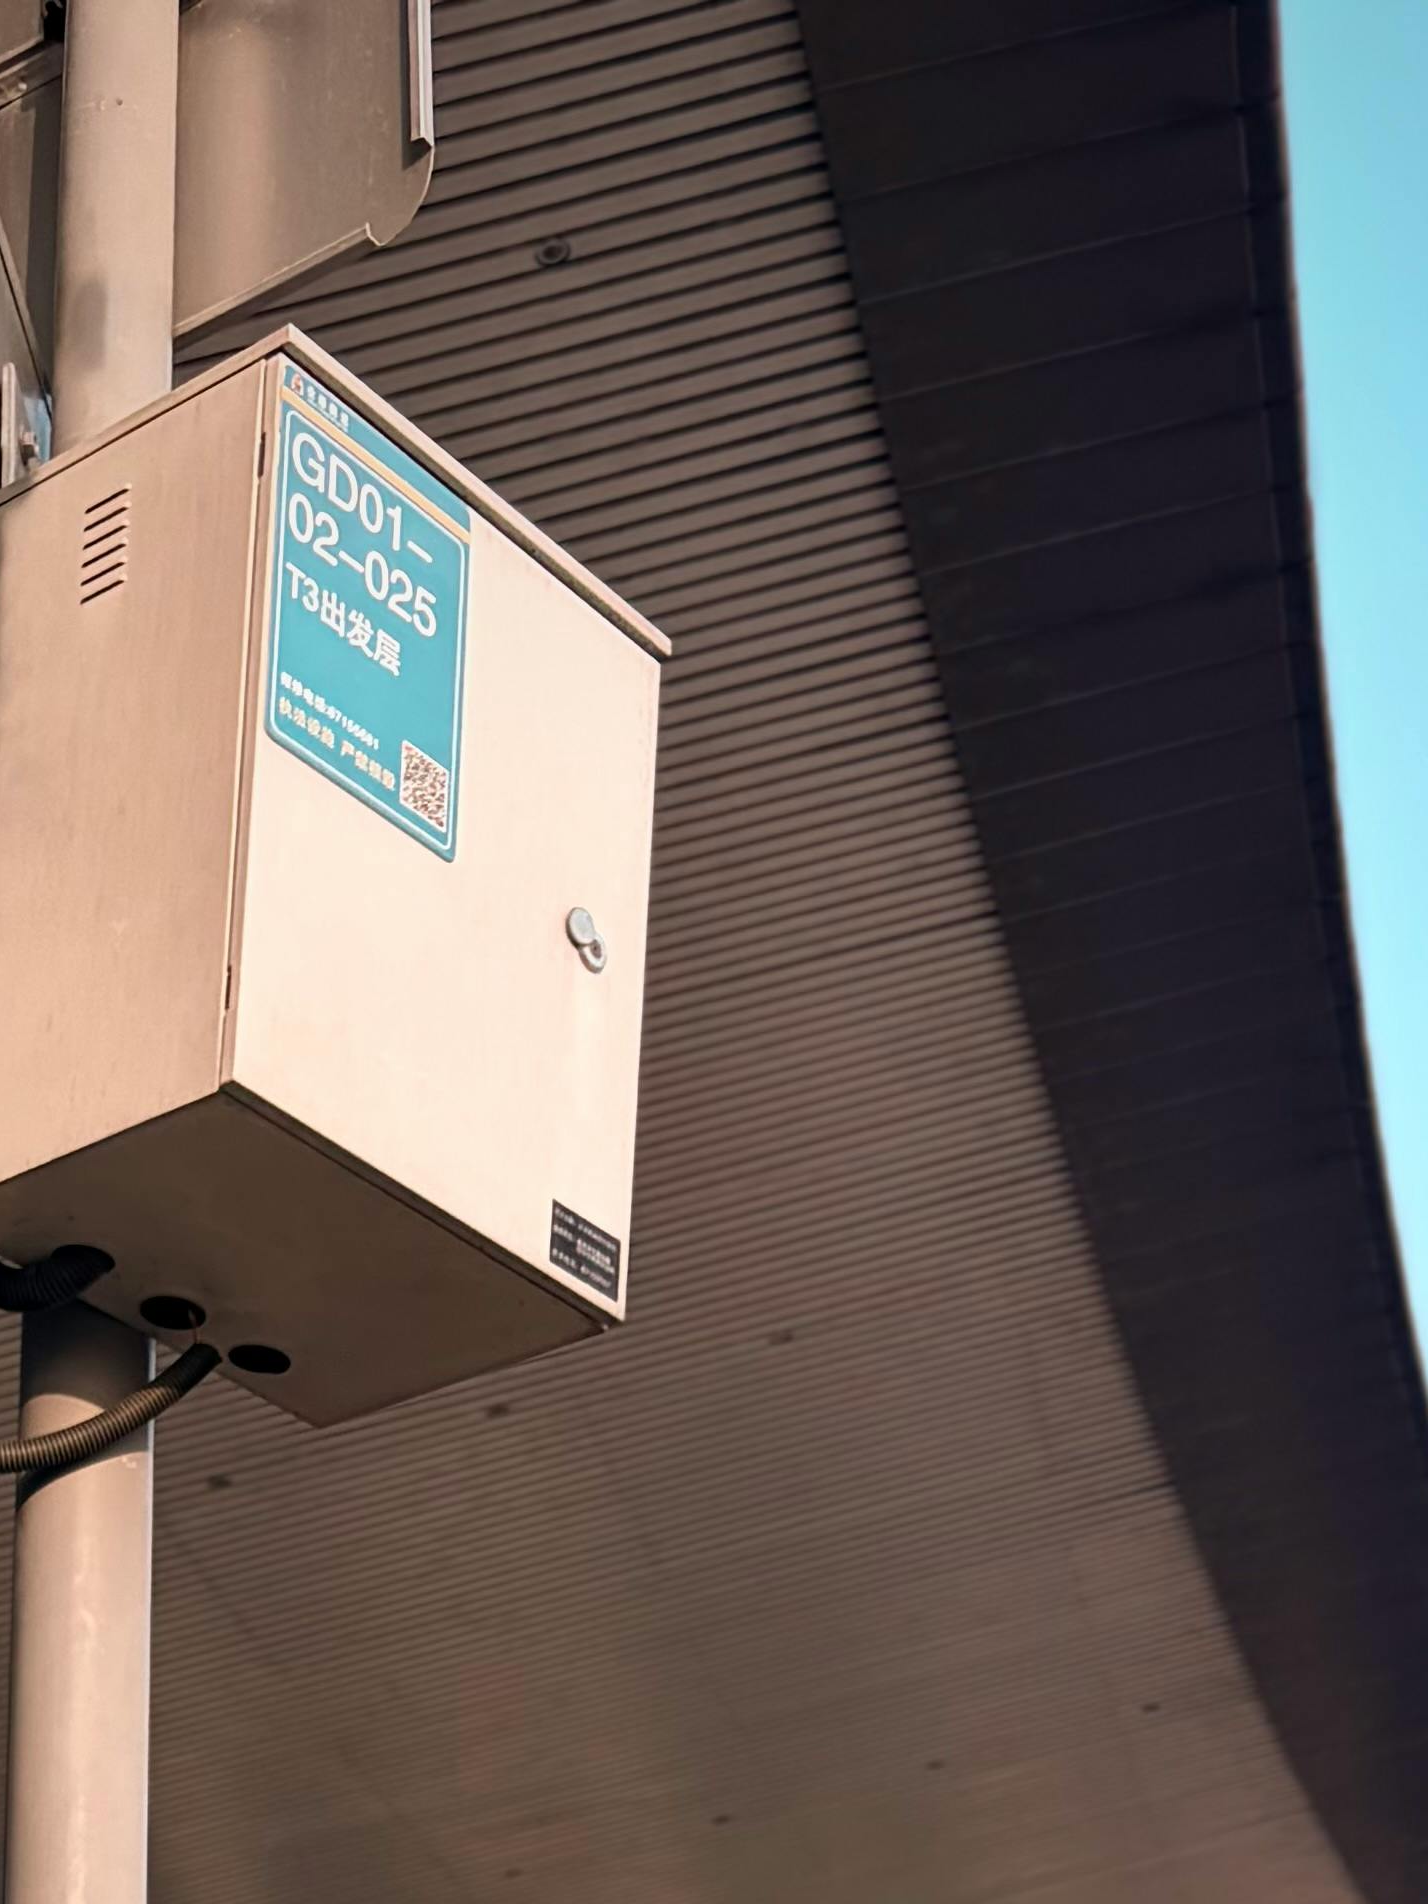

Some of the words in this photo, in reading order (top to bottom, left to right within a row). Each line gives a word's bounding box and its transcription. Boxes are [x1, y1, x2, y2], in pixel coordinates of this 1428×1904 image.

[292, 432, 433, 563] GD01-
[285, 561, 401, 677] T3出发层
[288, 492, 437, 637] 02-025
